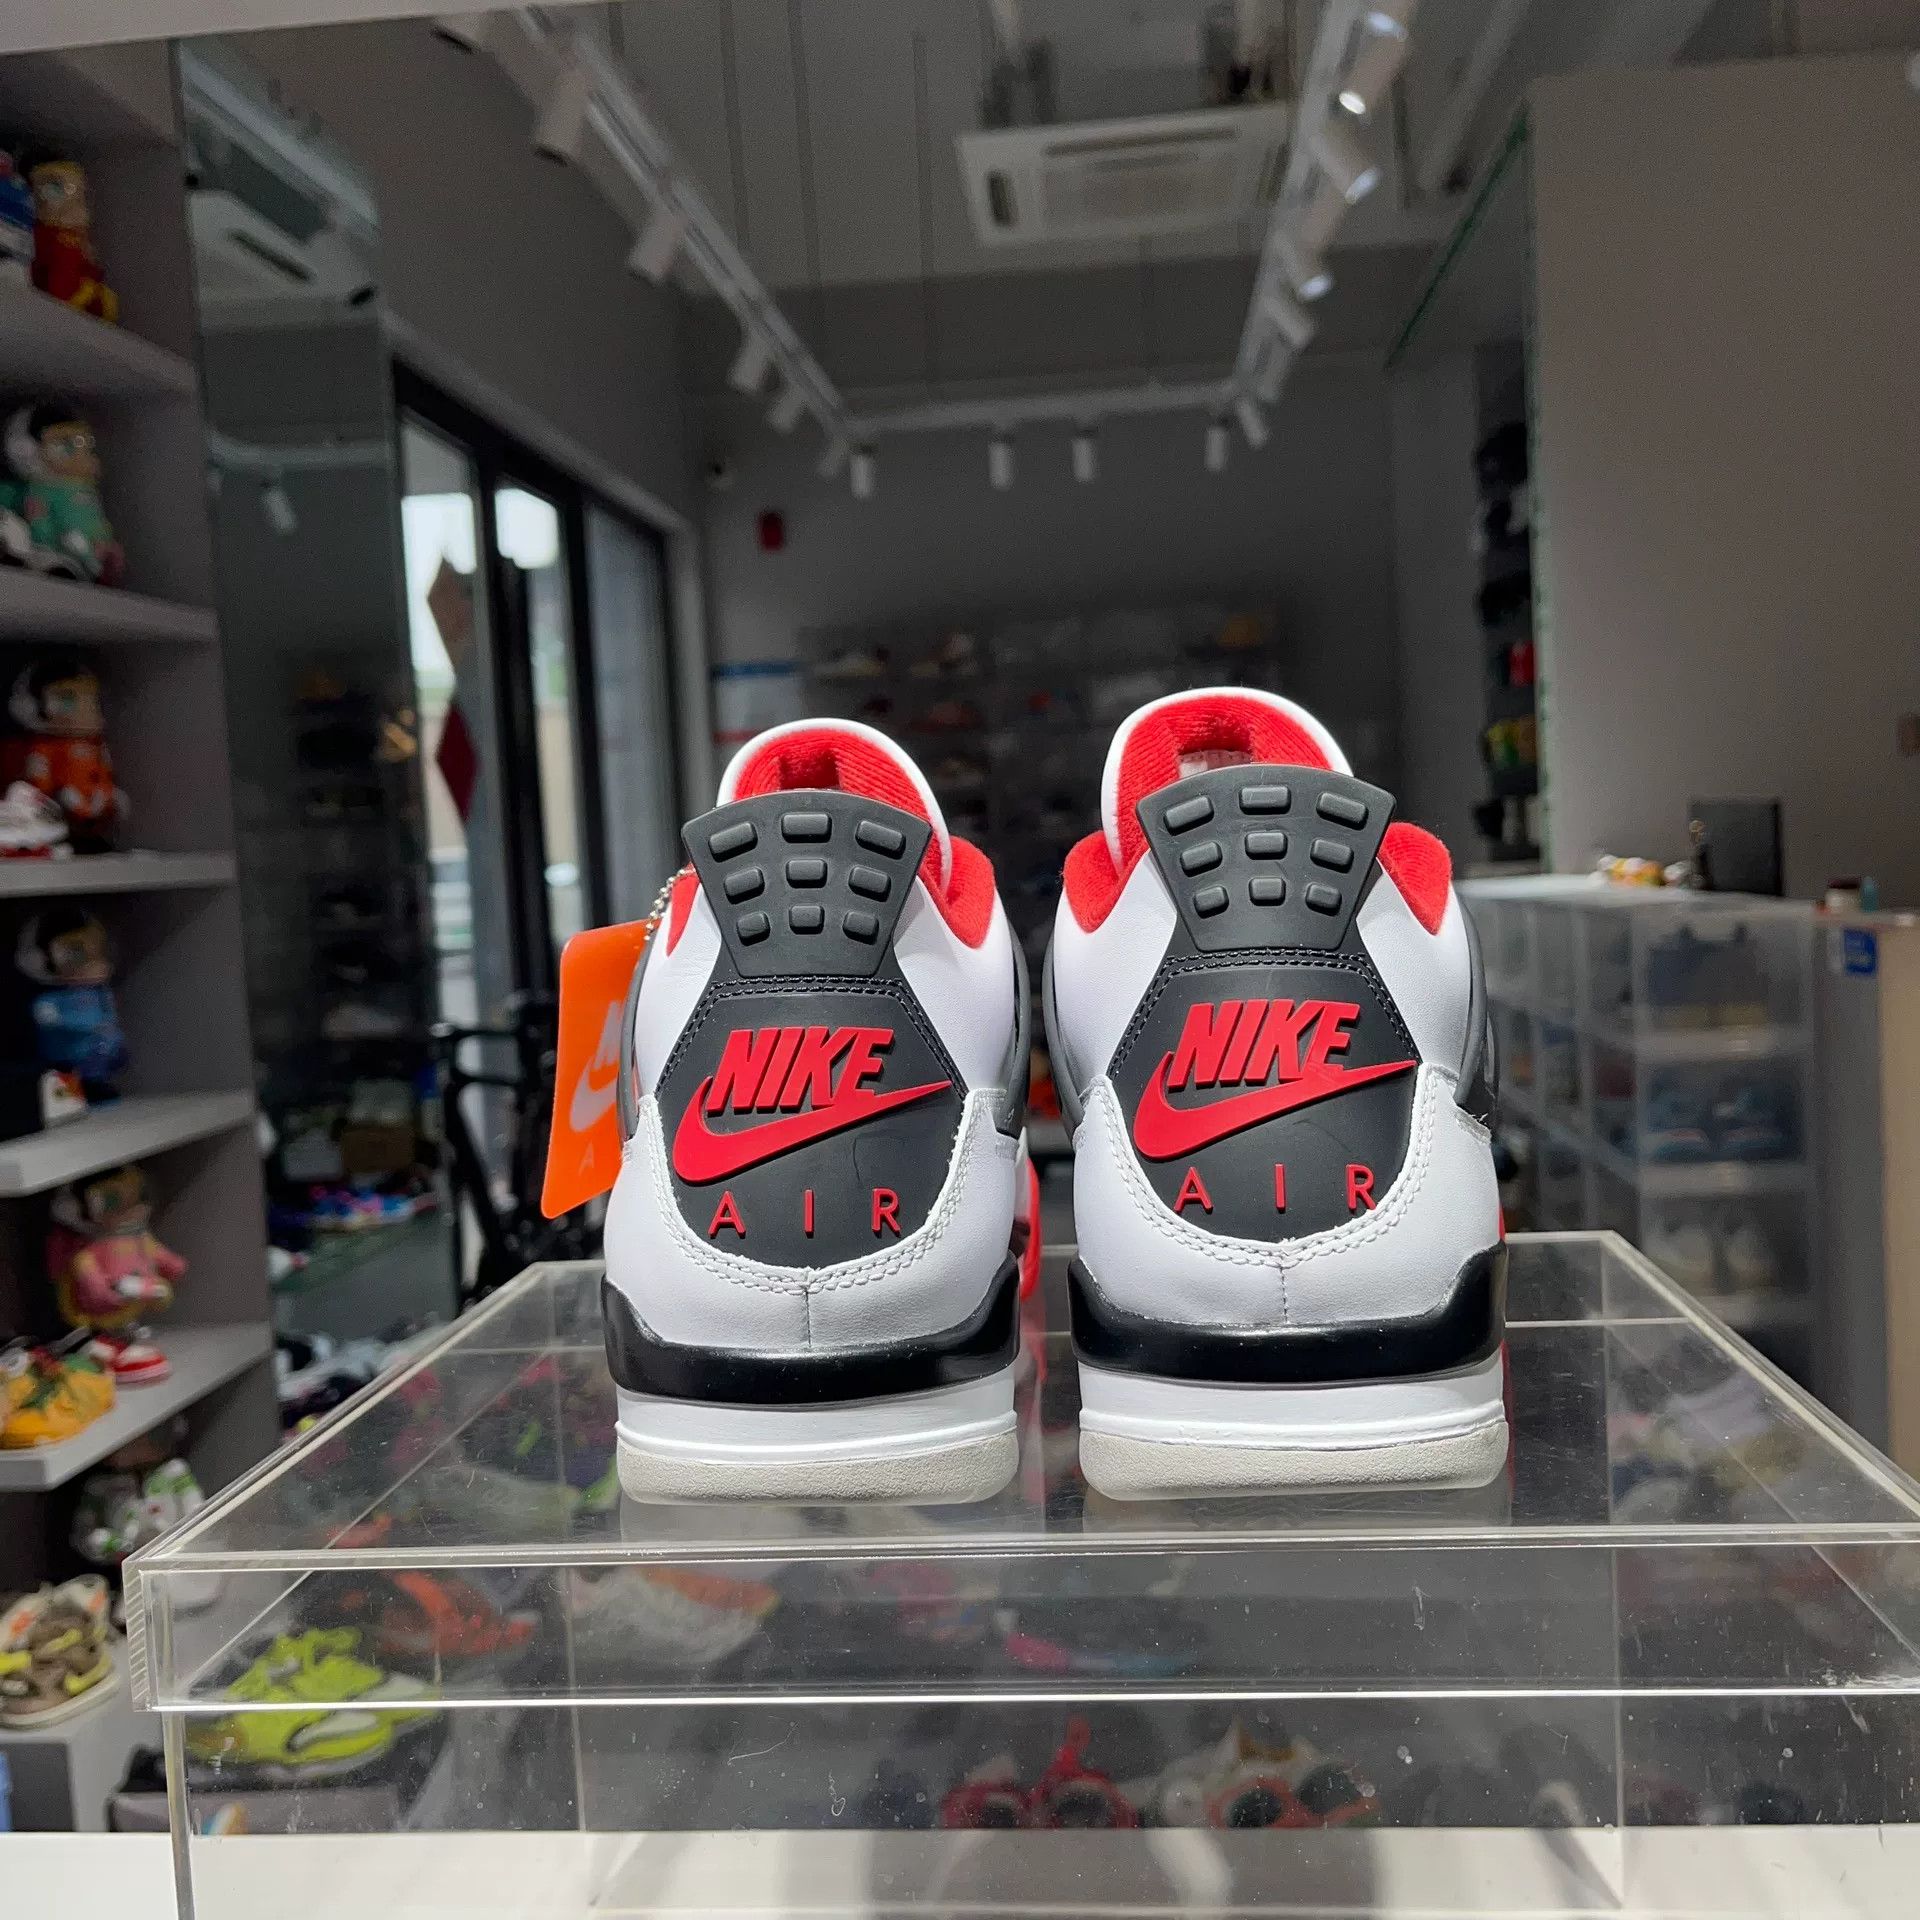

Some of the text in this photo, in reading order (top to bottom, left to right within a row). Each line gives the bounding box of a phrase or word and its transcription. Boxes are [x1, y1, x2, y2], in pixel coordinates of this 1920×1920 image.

[704, 1026, 895, 1113] NIKE
[1167, 1000, 1360, 1089] NIKE
[707, 1188, 901, 1238] AIR
[1174, 1163, 1377, 1213] AIR
